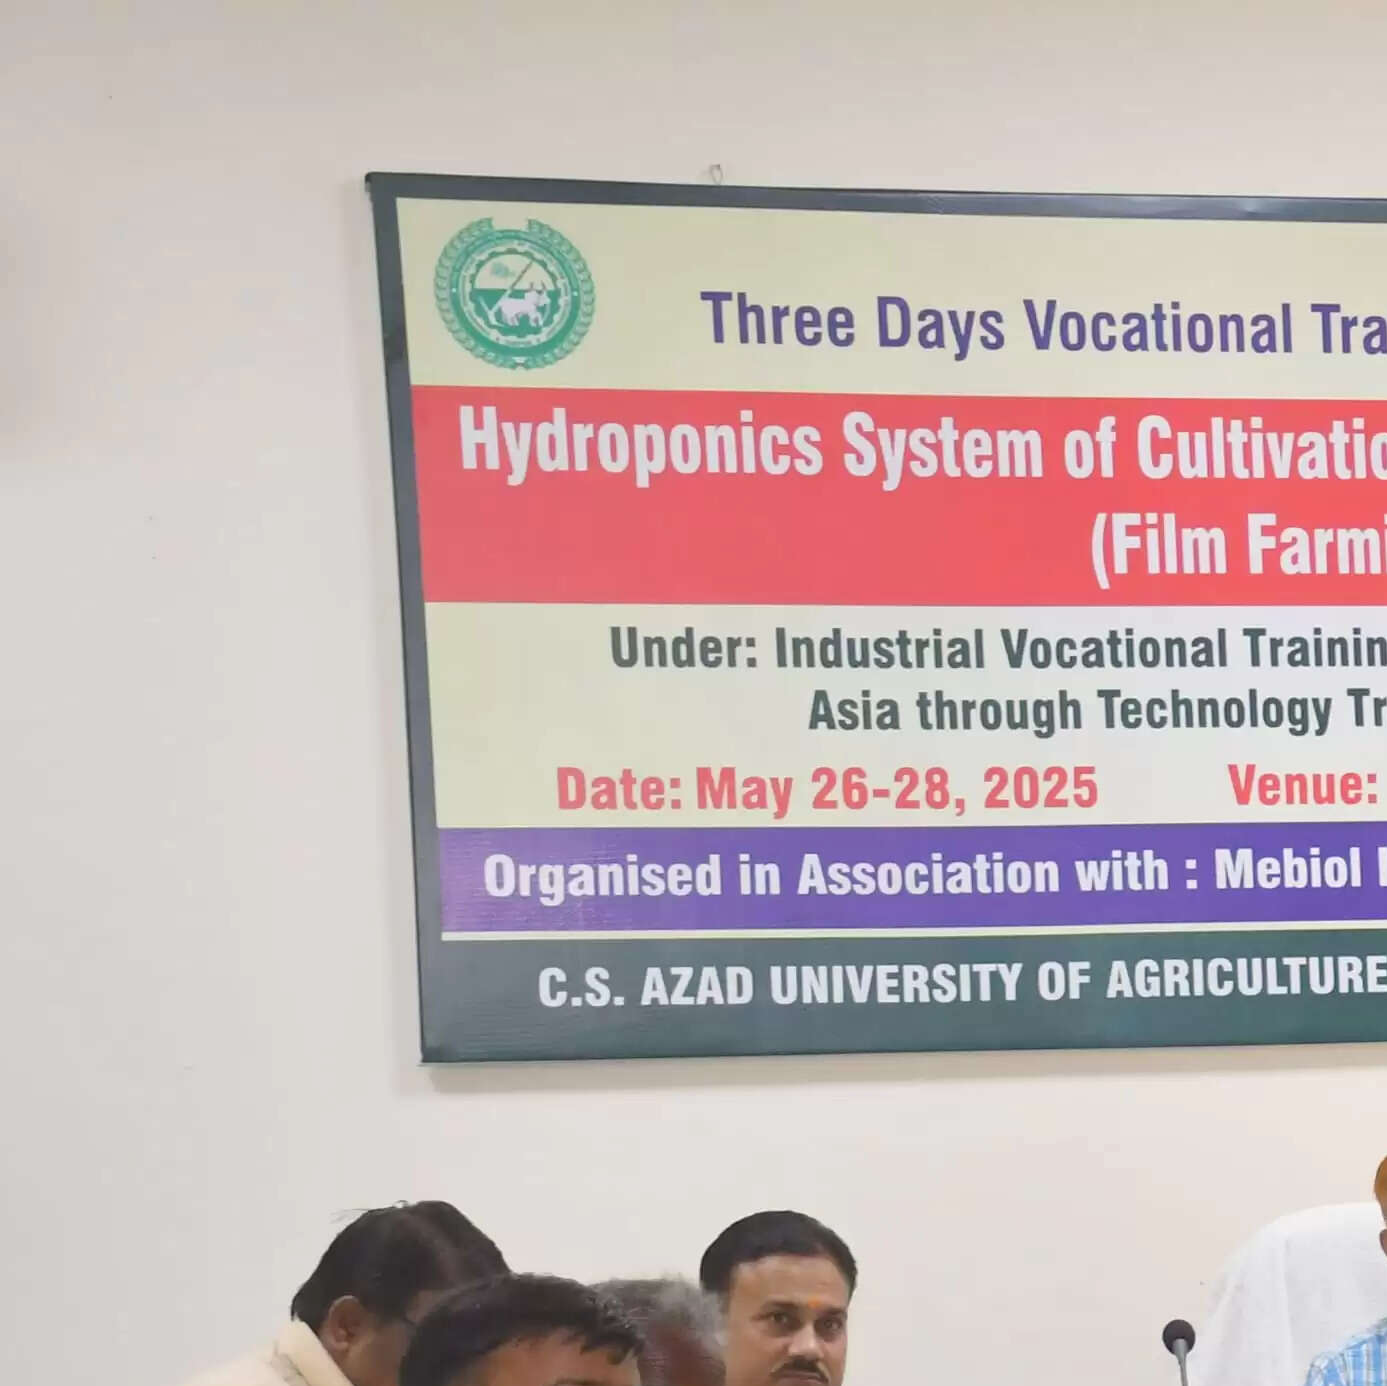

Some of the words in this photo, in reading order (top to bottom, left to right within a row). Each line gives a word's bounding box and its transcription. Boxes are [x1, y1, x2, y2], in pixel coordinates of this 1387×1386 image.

[700, 291, 854, 347] Three
[877, 296, 1004, 361] Days
[1023, 299, 1292, 353] Vocational
[459, 405, 823, 488] Hydroponics
[843, 411, 1043, 491] System
[1065, 416, 1116, 478] of
[1092, 512, 1227, 589] (Film
[611, 627, 756, 668] Under:
[776, 627, 984, 668] Industrial
[1000, 628, 1227, 669] Vocational
[809, 690, 900, 730] Asia
[916, 690, 1081, 738] through
[1097, 689, 1332, 736] Technology
[557, 767, 681, 810] Date:
[696, 767, 793, 819] May
[812, 767, 965, 816] 26-28,
[984, 766, 1097, 808] 2025
[1228, 764, 1377, 805] Venue:
[484, 854, 721, 906] Organised
[739, 854, 780, 895] in
[798, 852, 1059, 895] Association
[1075, 850, 1168, 891] with
[1215, 847, 1361, 889] Mebiol
[539, 967, 624, 1007] C.S.
[641, 967, 753, 1005] AZAD
[771, 963, 1022, 1004] UNIVERSITY
[1038, 961, 1090, 1000] OF
